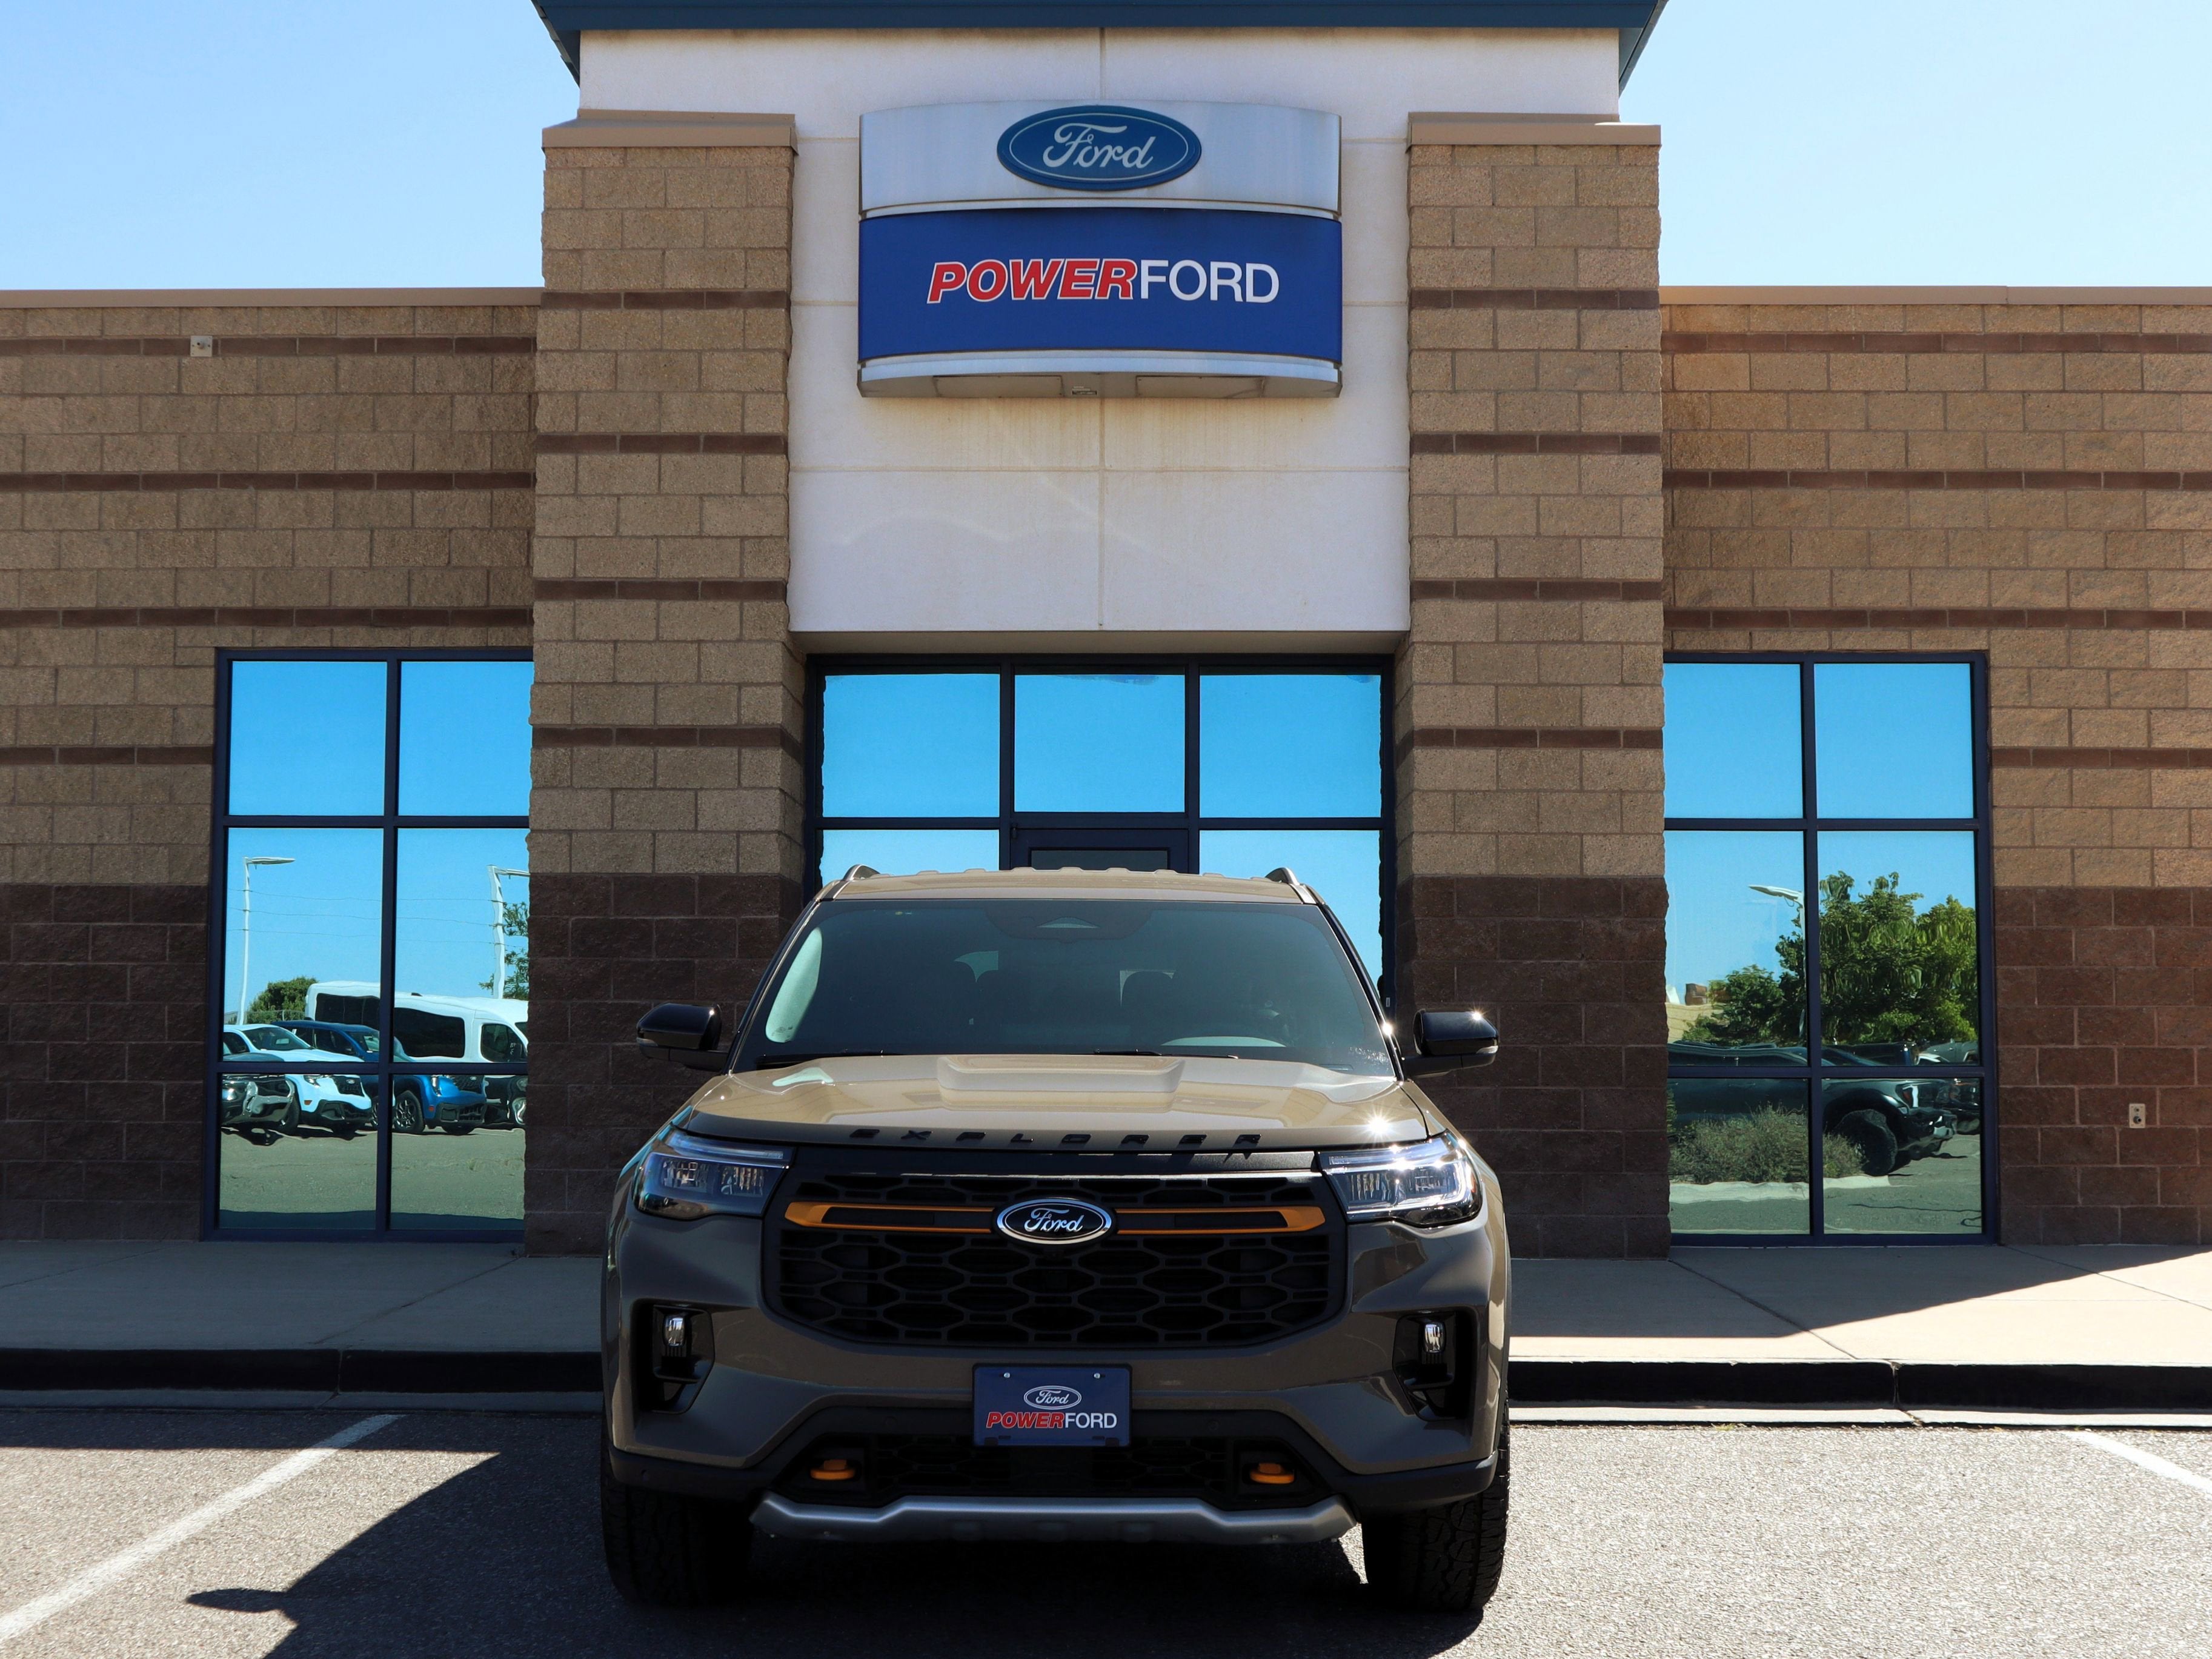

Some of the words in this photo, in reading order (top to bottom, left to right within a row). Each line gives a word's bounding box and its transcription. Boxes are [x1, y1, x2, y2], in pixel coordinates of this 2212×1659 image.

[1043, 122, 1157, 168] Ford
[849, 1129, 1262, 1145] EXPLORER
[1024, 1208, 1084, 1232] Ford
[1035, 1390, 1070, 1405] Ford
